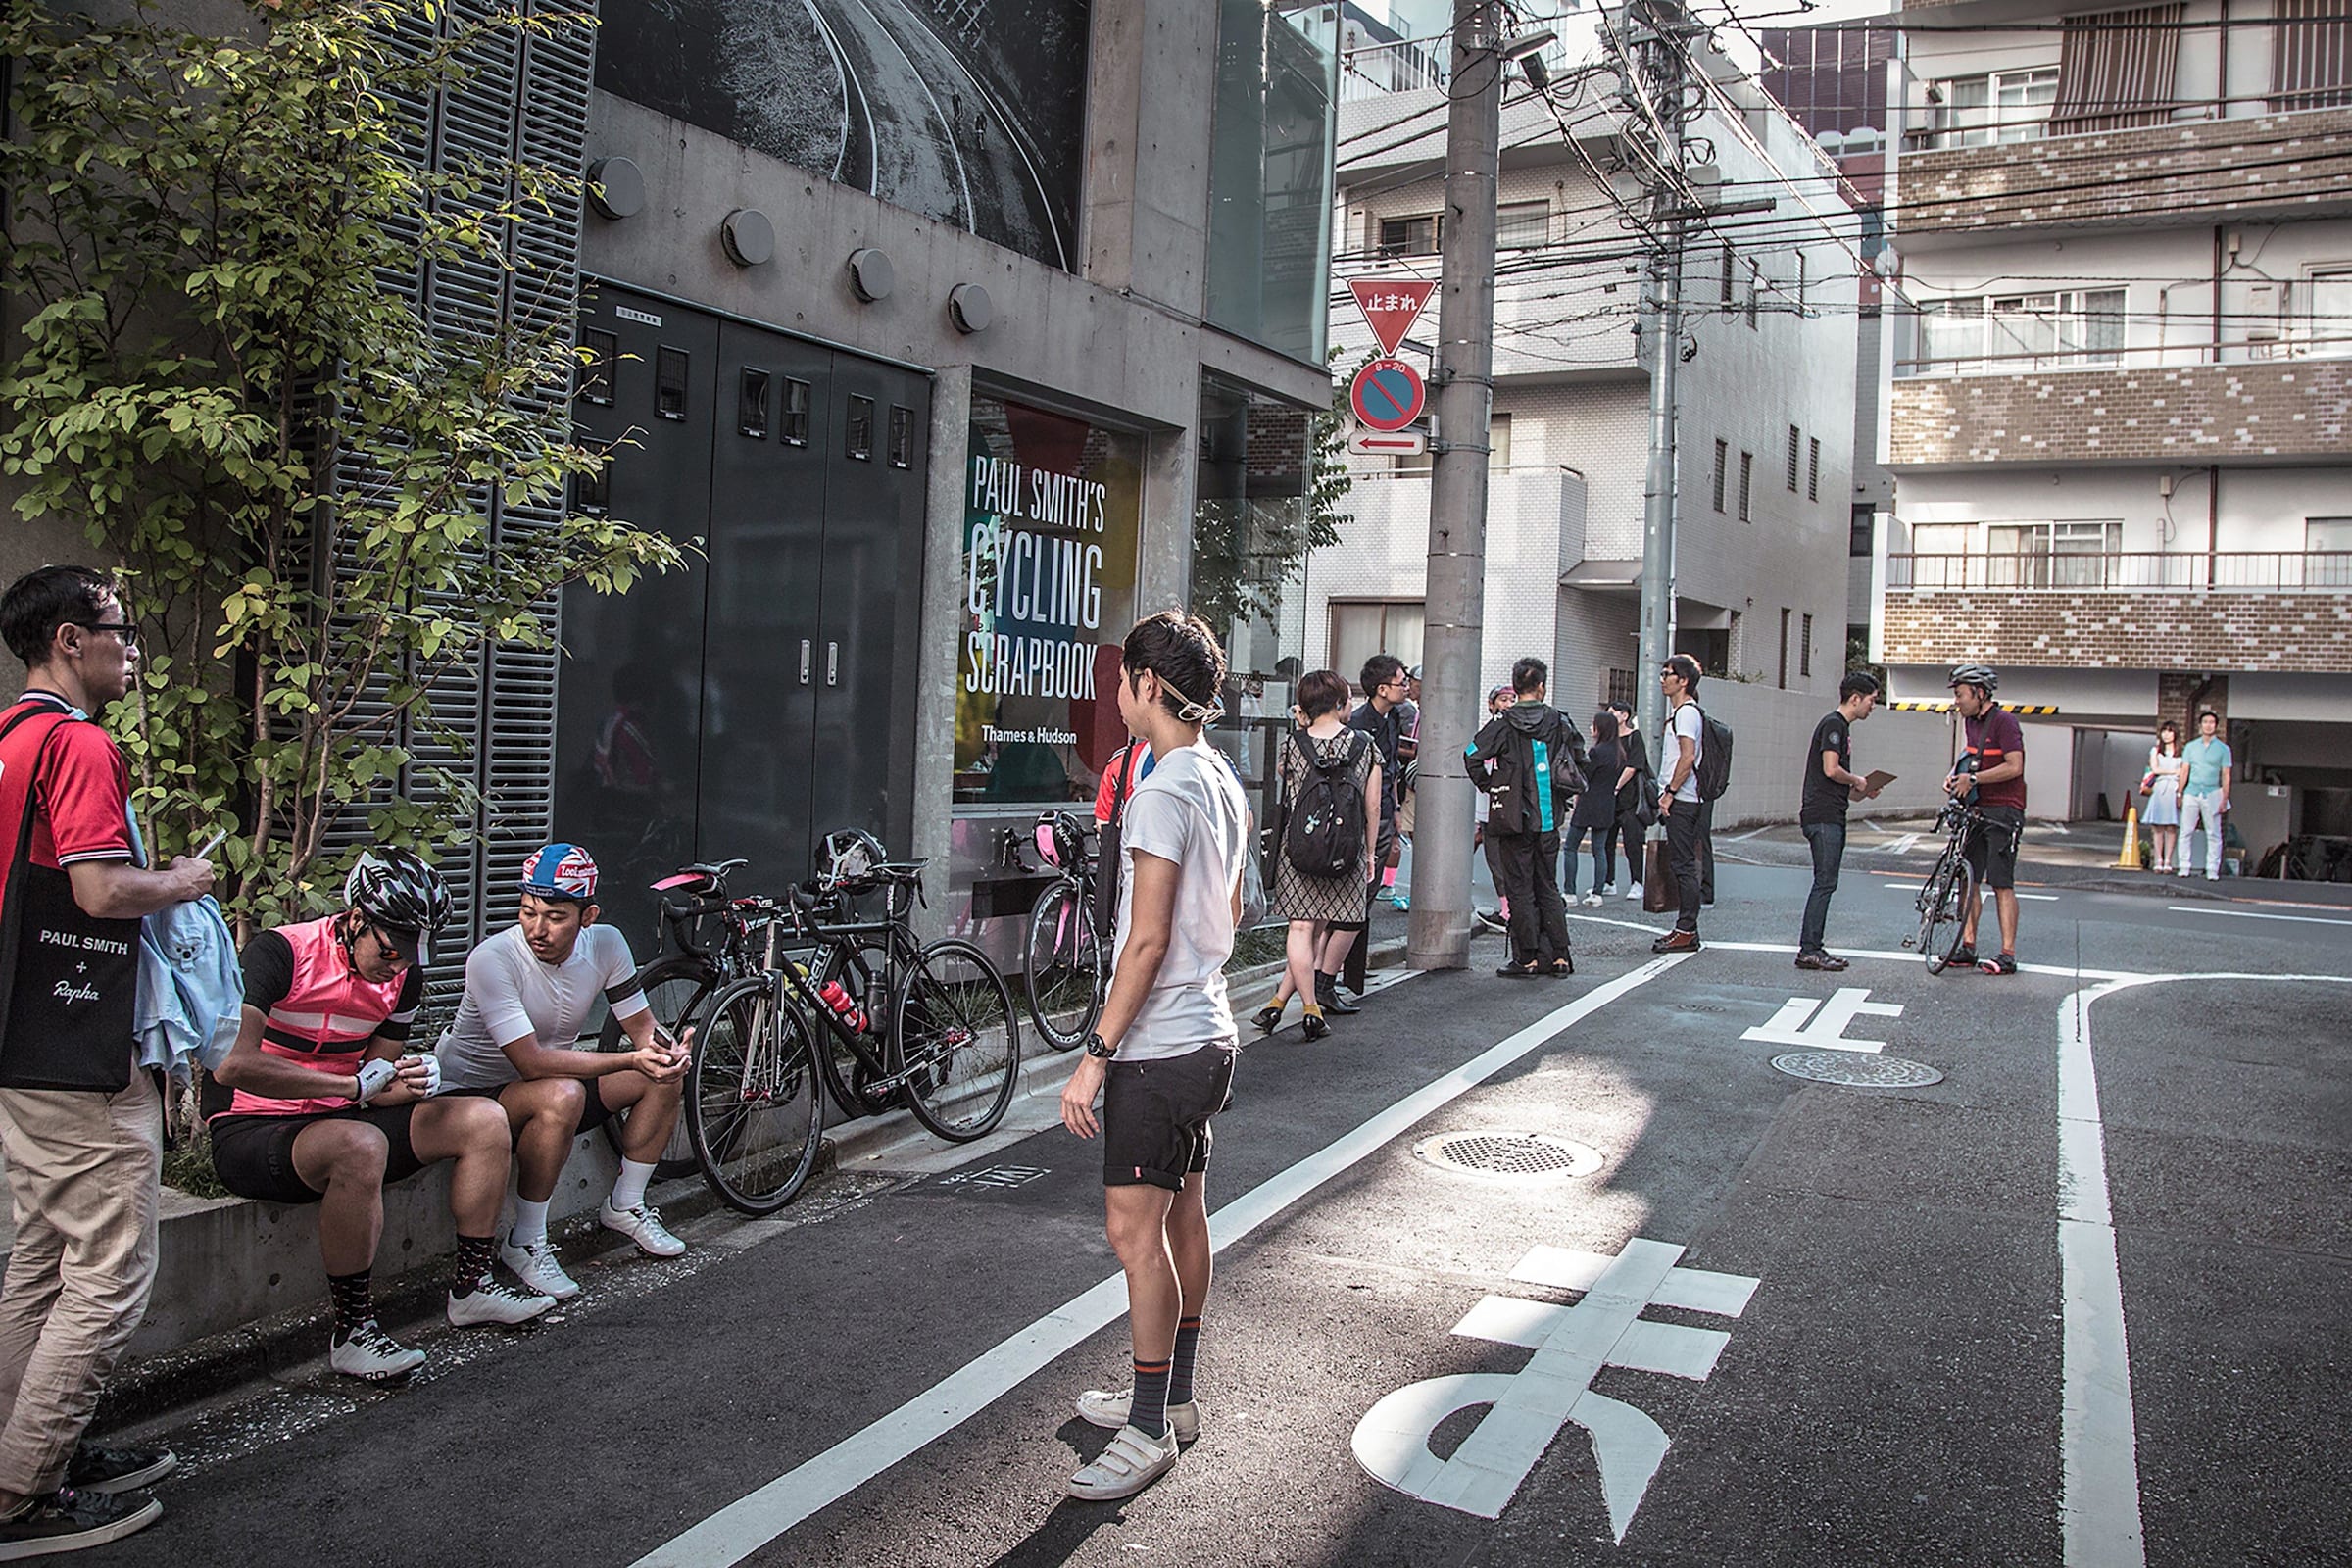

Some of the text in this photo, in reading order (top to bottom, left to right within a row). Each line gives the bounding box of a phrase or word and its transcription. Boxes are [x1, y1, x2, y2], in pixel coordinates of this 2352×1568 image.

[1366, 293, 1417, 311] 止まれ
[1375, 362, 1406, 372] 8-20
[973, 455, 1106, 533] PAUL SMITH'S
[968, 522, 1102, 629] CYCLING
[965, 630, 1098, 701] SCRAPBOOK
[981, 724, 1077, 745] Thames & Hudson
[39, 930, 128, 956] PAUL SMITH
[53, 980, 100, 1005] Rapha
